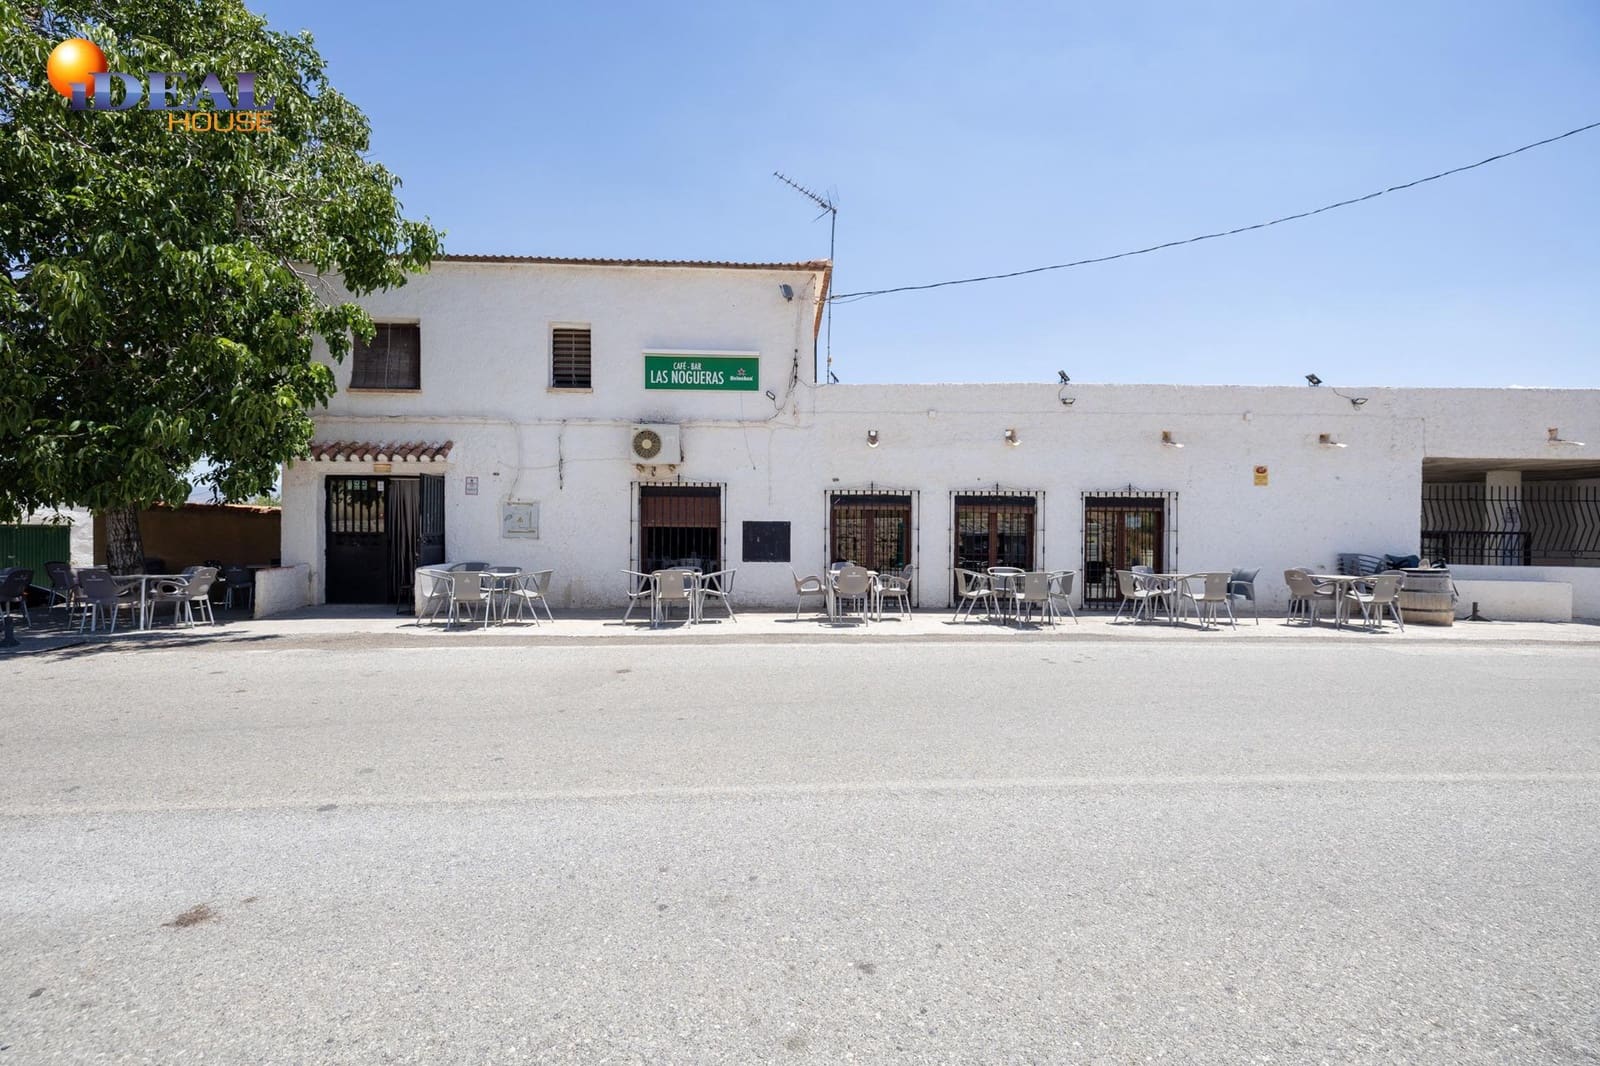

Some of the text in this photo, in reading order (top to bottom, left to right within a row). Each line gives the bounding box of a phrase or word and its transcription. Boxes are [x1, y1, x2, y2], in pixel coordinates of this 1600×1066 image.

[690, 362, 702, 370] BAR
[651, 370, 668, 384] LAS
[671, 370, 724, 385] NOGUERAS
